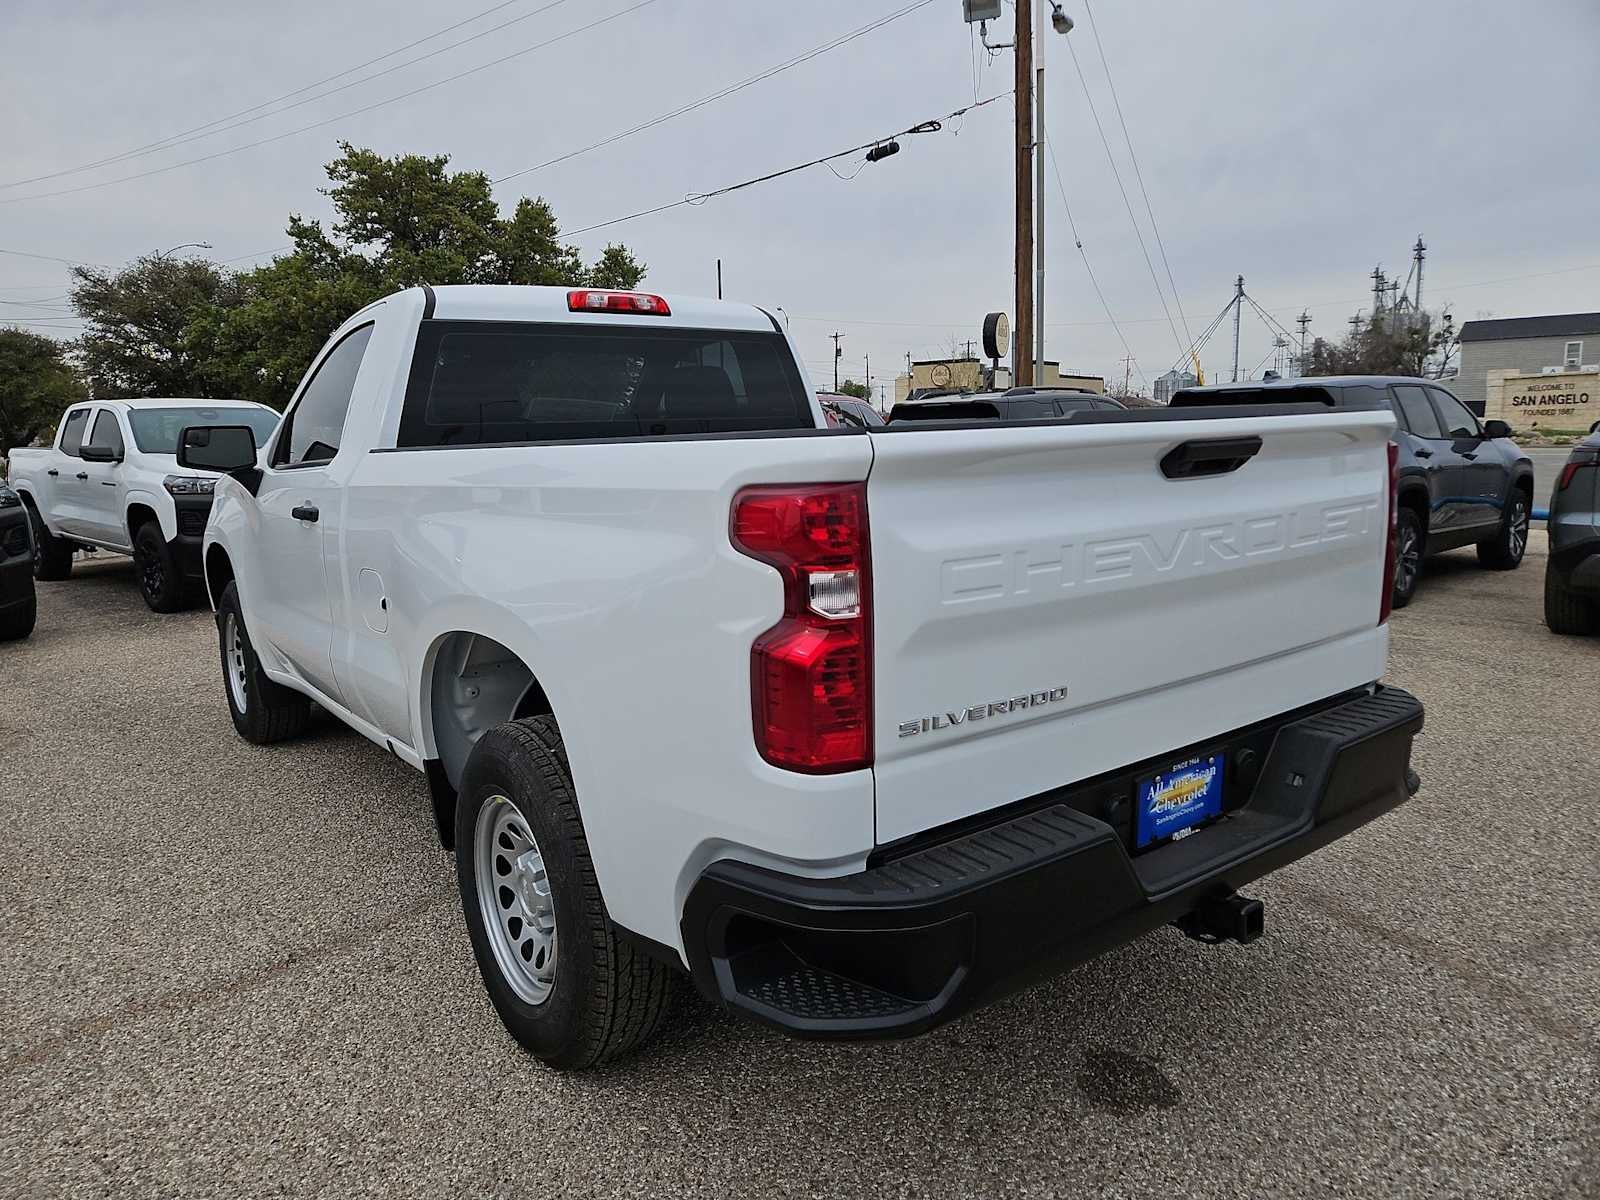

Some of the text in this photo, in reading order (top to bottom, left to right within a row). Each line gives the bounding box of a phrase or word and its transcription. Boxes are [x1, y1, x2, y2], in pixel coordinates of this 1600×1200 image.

[1512, 393, 1589, 406] SAN ANGELO
[1528, 383, 1562, 392] WELCOME
[941, 502, 1378, 605] CHEVROLET
[899, 686, 1067, 737] SILVERADO
[1172, 760, 1188, 772] SINCE
[1147, 766, 1216, 800] All American
[1154, 784, 1208, 814] Chevrolet
